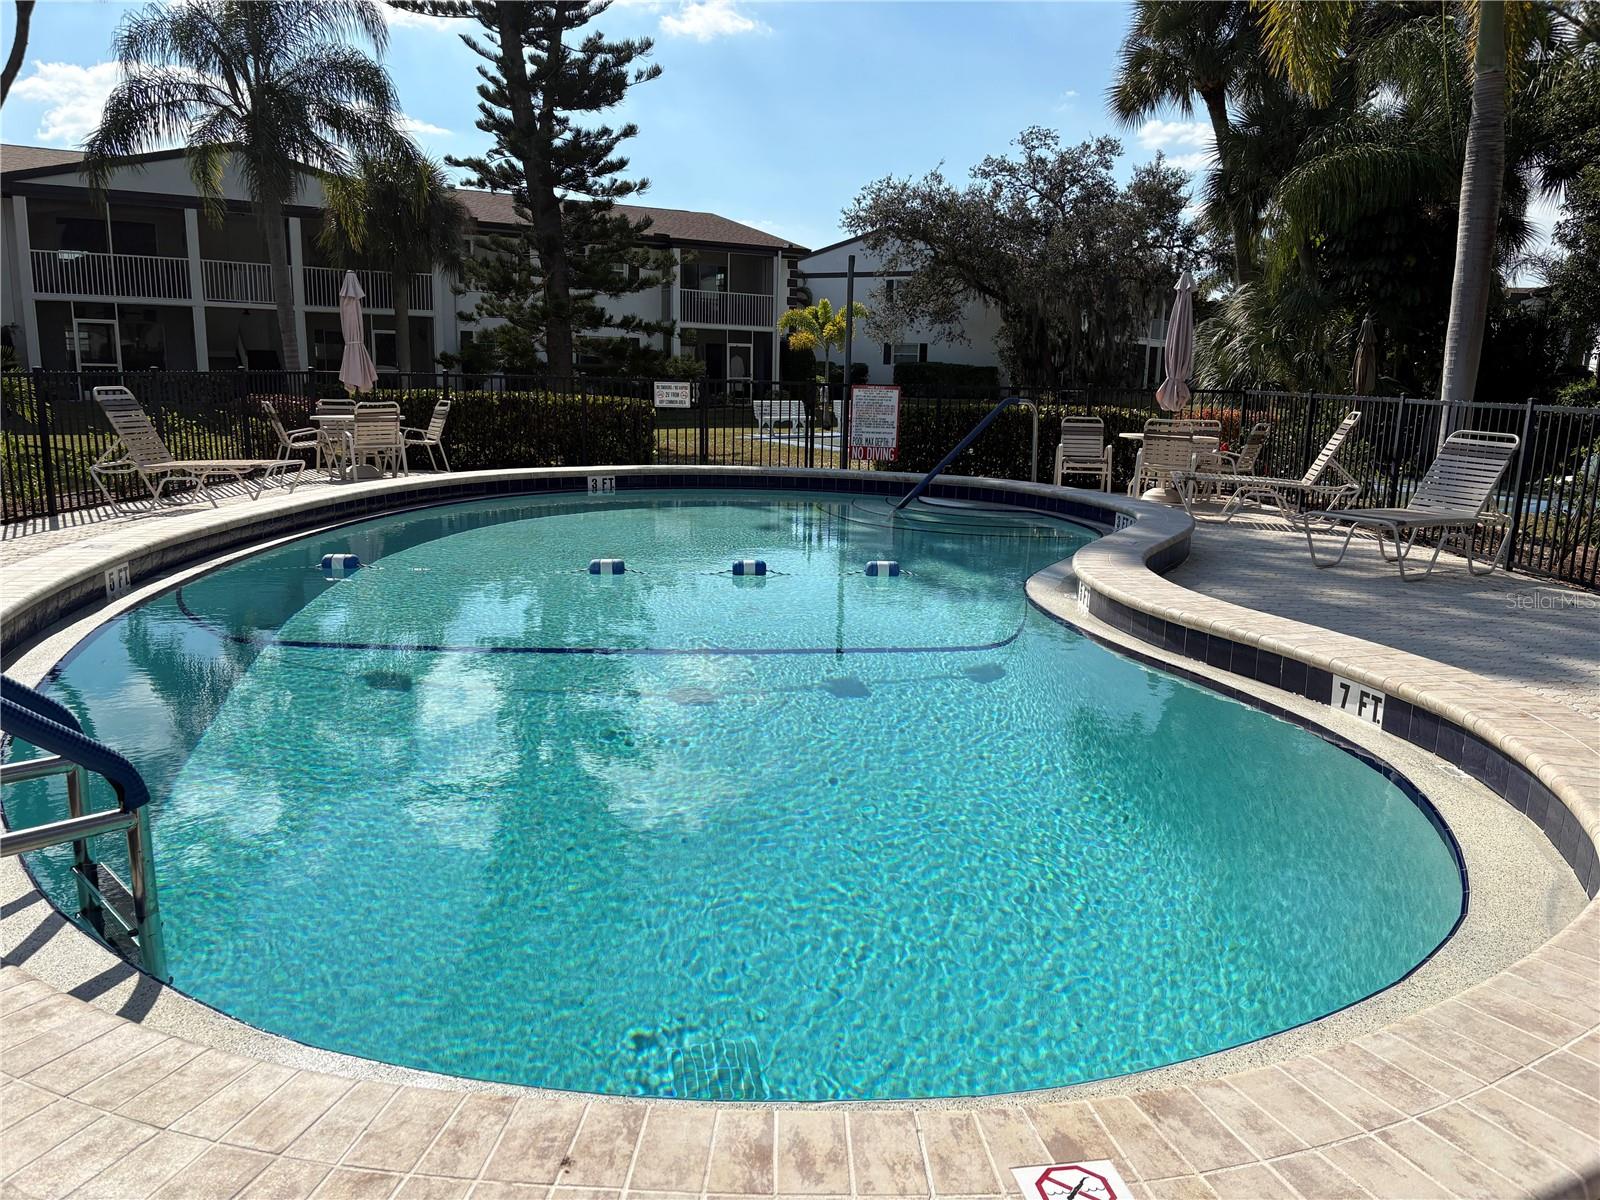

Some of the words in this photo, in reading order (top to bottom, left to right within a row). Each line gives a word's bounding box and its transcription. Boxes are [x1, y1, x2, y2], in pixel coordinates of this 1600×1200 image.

[852, 436, 863, 445] POOL
[865, 438, 874, 446] MAX
[852, 447, 864, 460] NO
[867, 448, 895, 461] DIVING
[592, 478, 598, 490] 3
[108, 572, 114, 592] 5
[1340, 682, 1351, 709] 7
[1358, 690, 1383, 724] FT.
